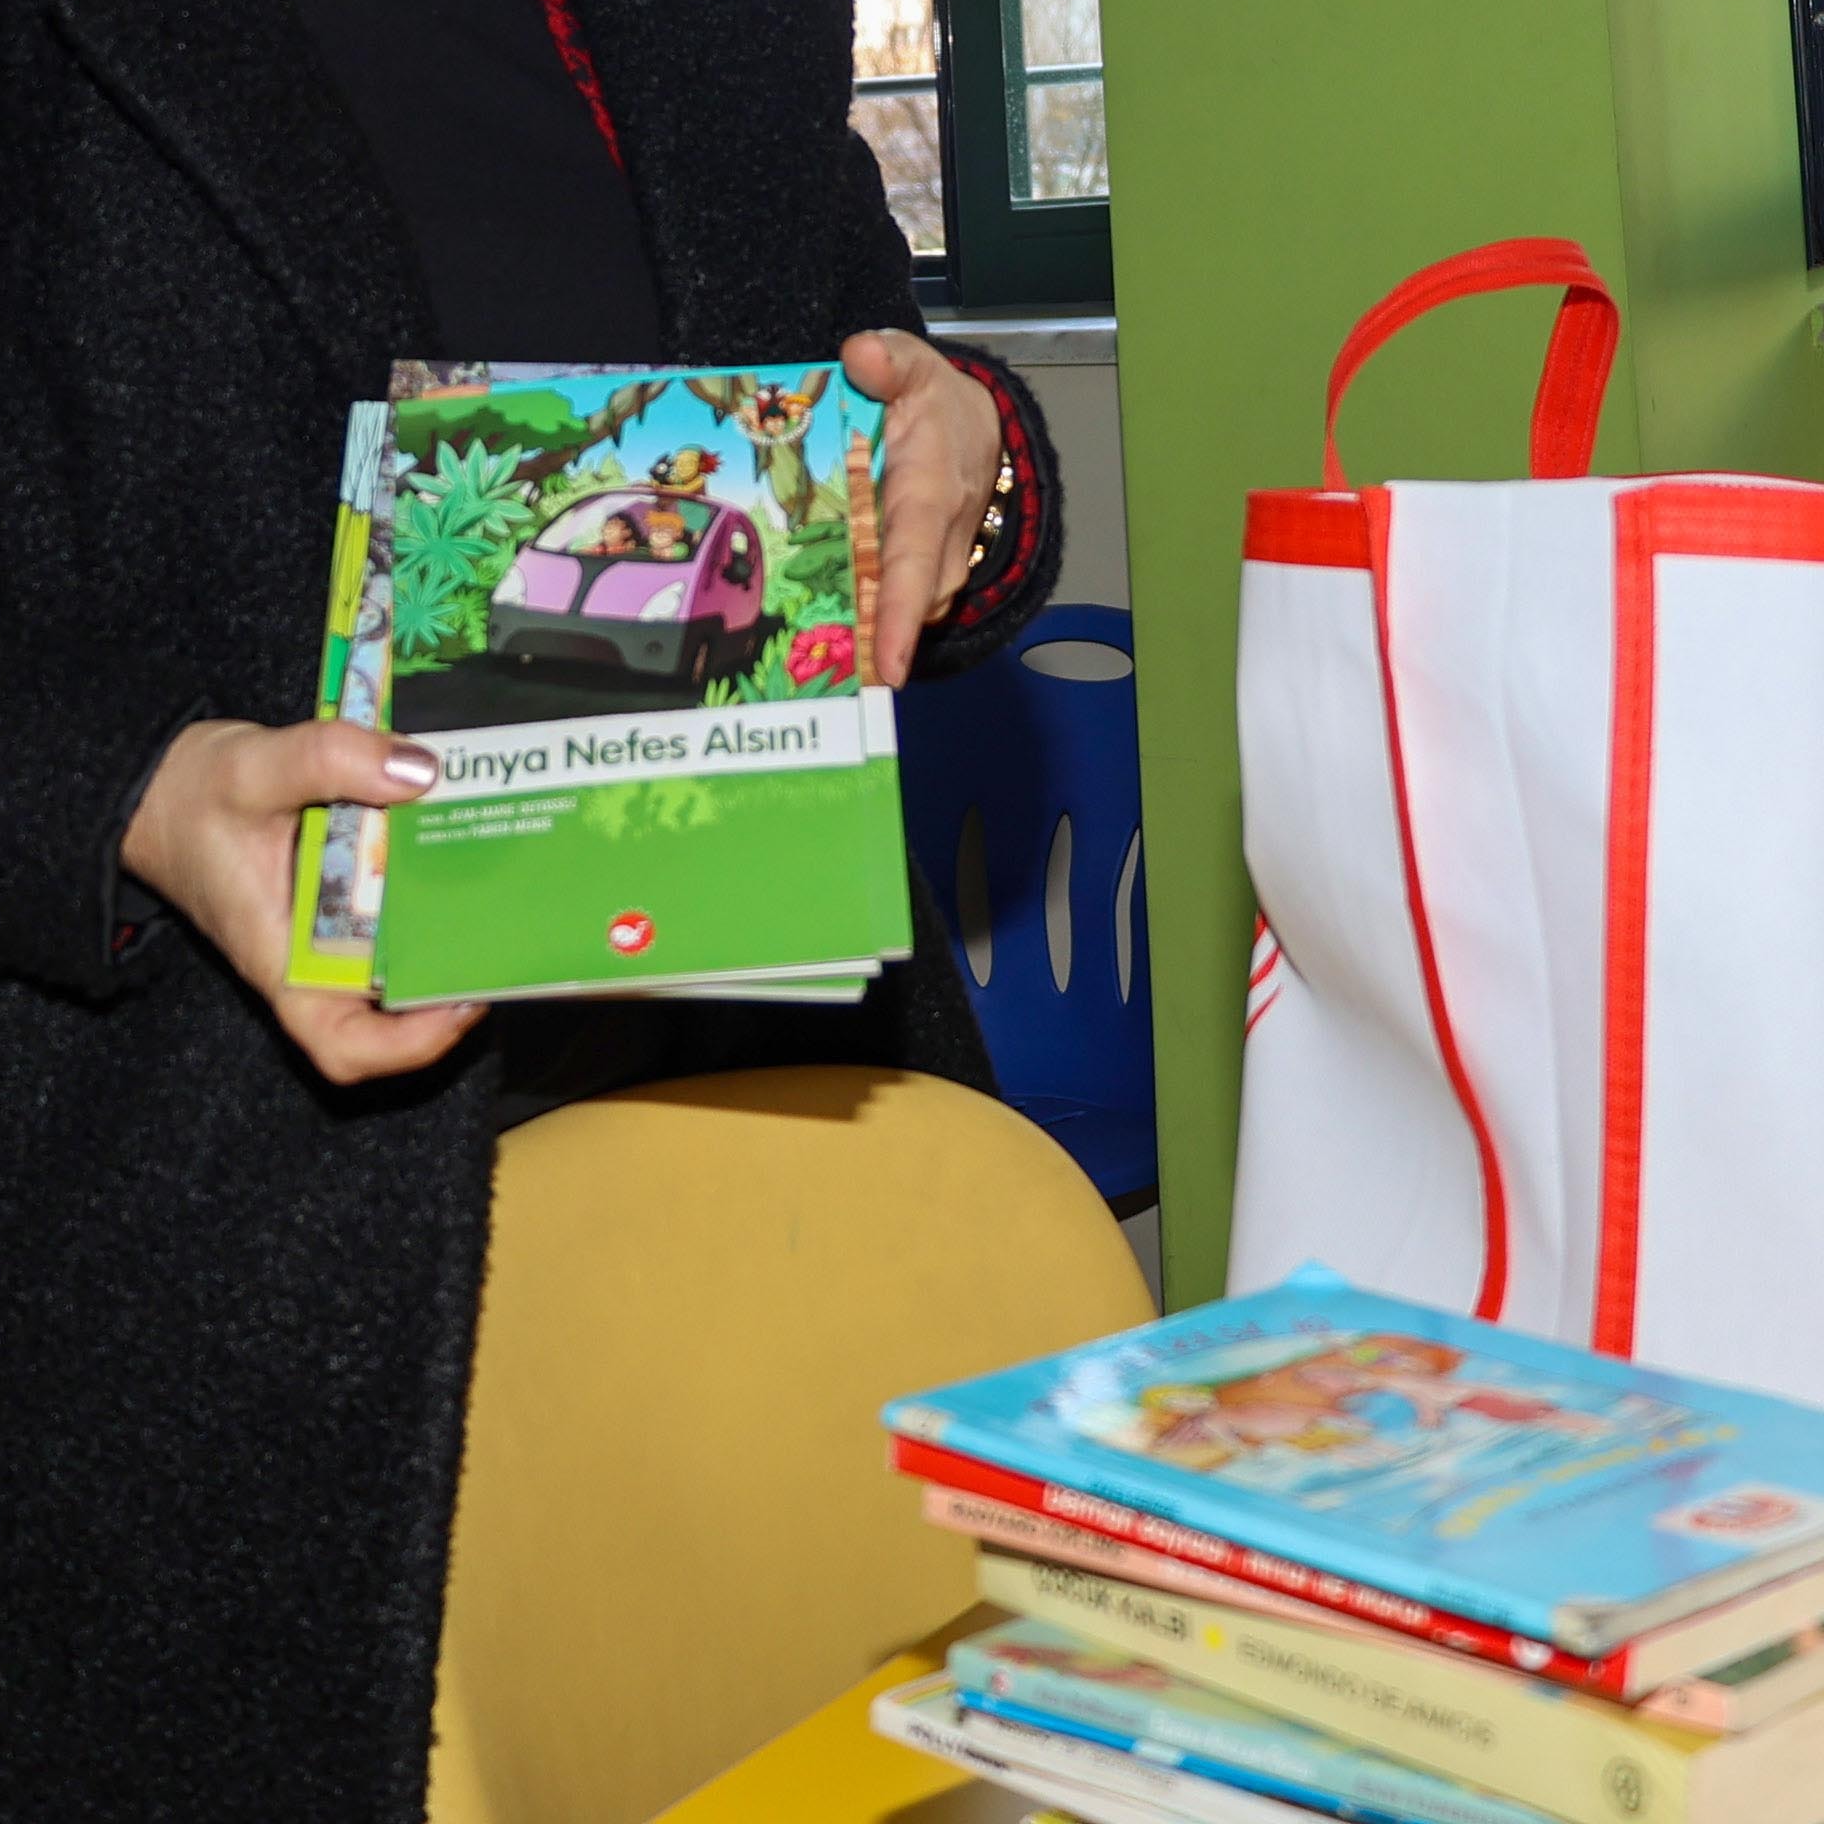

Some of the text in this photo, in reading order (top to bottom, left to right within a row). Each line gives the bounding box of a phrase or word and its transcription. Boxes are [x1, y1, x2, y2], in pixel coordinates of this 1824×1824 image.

[440, 717, 819, 785] ünya Nefes Alsın!
